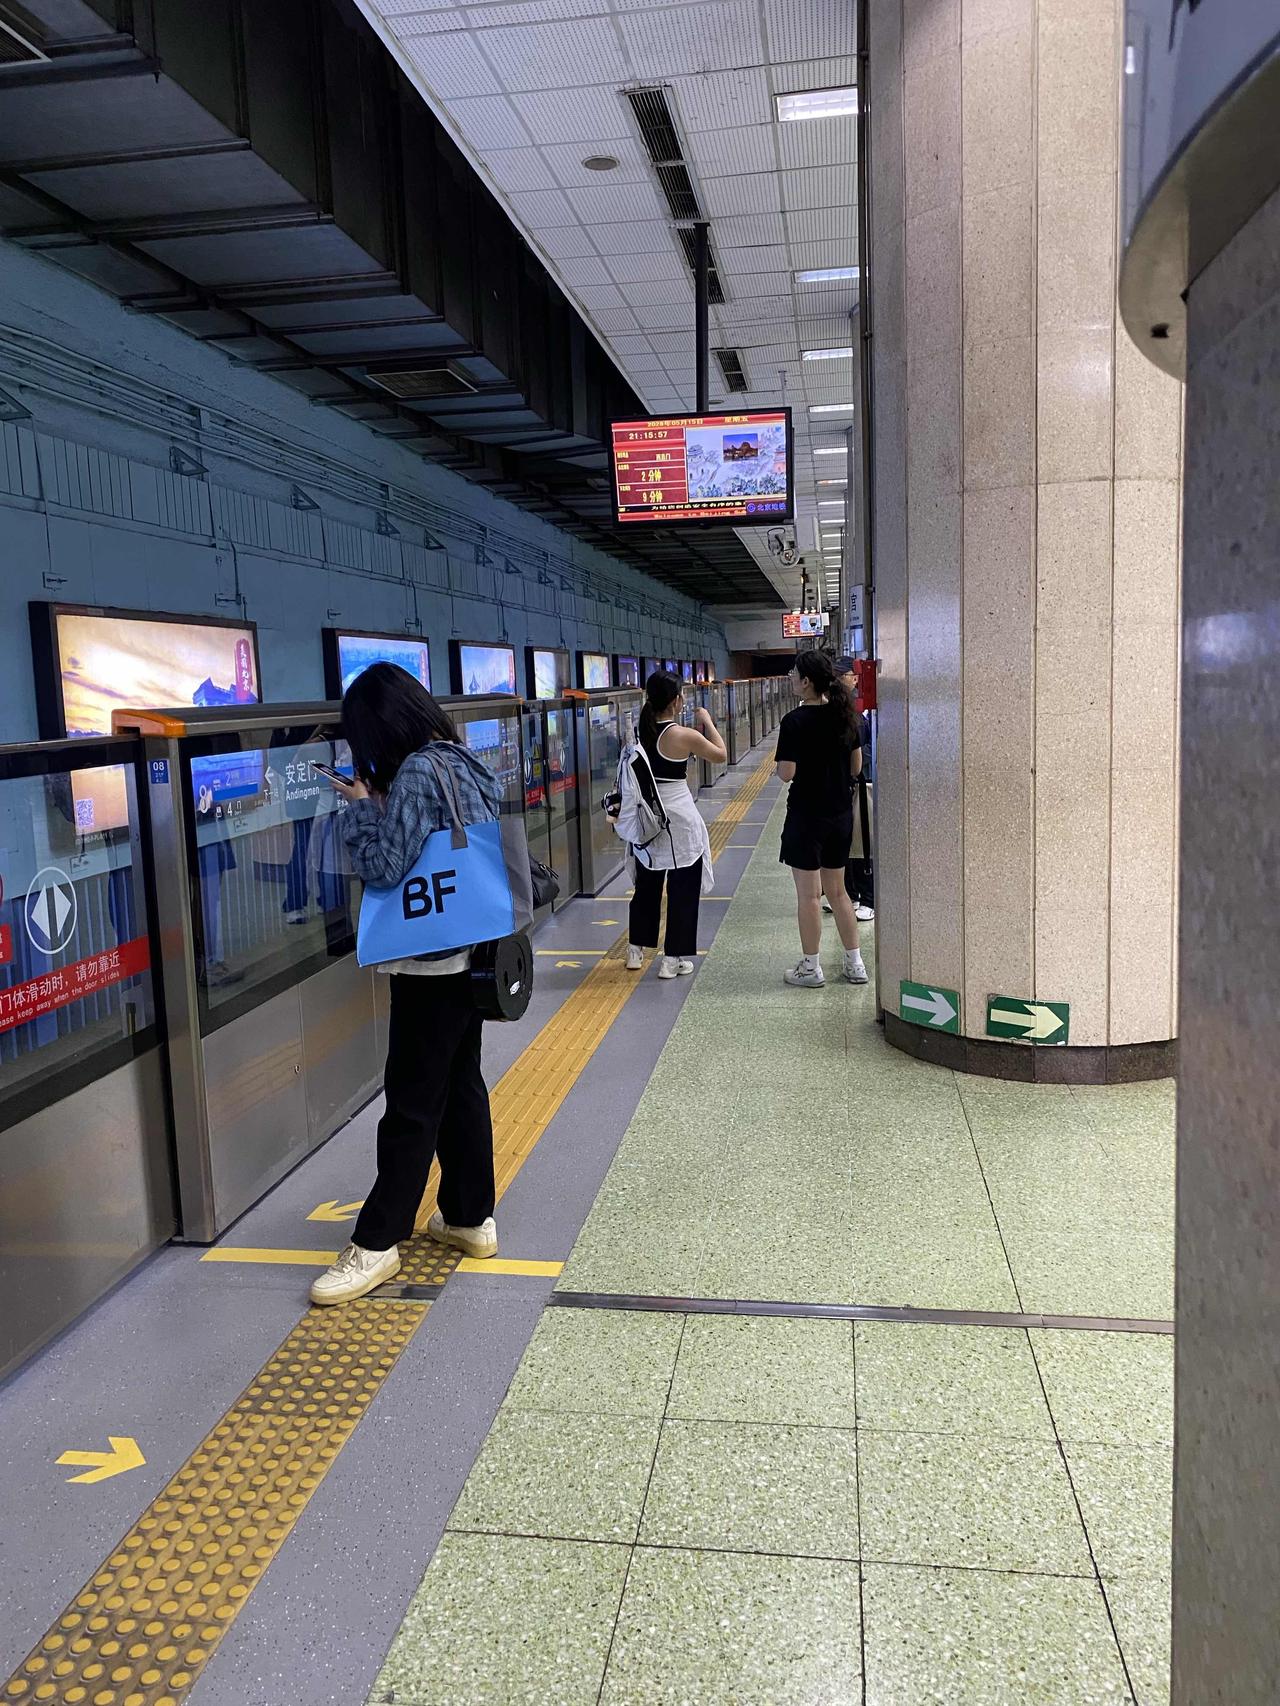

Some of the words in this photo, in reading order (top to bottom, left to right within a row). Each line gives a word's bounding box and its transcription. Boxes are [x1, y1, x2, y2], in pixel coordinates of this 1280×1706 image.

[629, 431, 668, 440] 21:15:57
[641, 471, 646, 482] 2
[648, 469, 662, 482] 分钟
[642, 492, 647, 503] 9
[649, 490, 663, 503] 分钟
[152, 761, 165, 771] 08
[285, 760, 317, 785] 安定门
[285, 786, 320, 801] Andingmen
[402, 869, 457, 920] BF
[17, 1007, 33, 1019] keep
[36, 1000, 52, 1011] away
[54, 992, 69, 1003] when
[71, 985, 83, 995] the
[84, 979, 98, 991] door
[100, 970, 120, 983] slides
